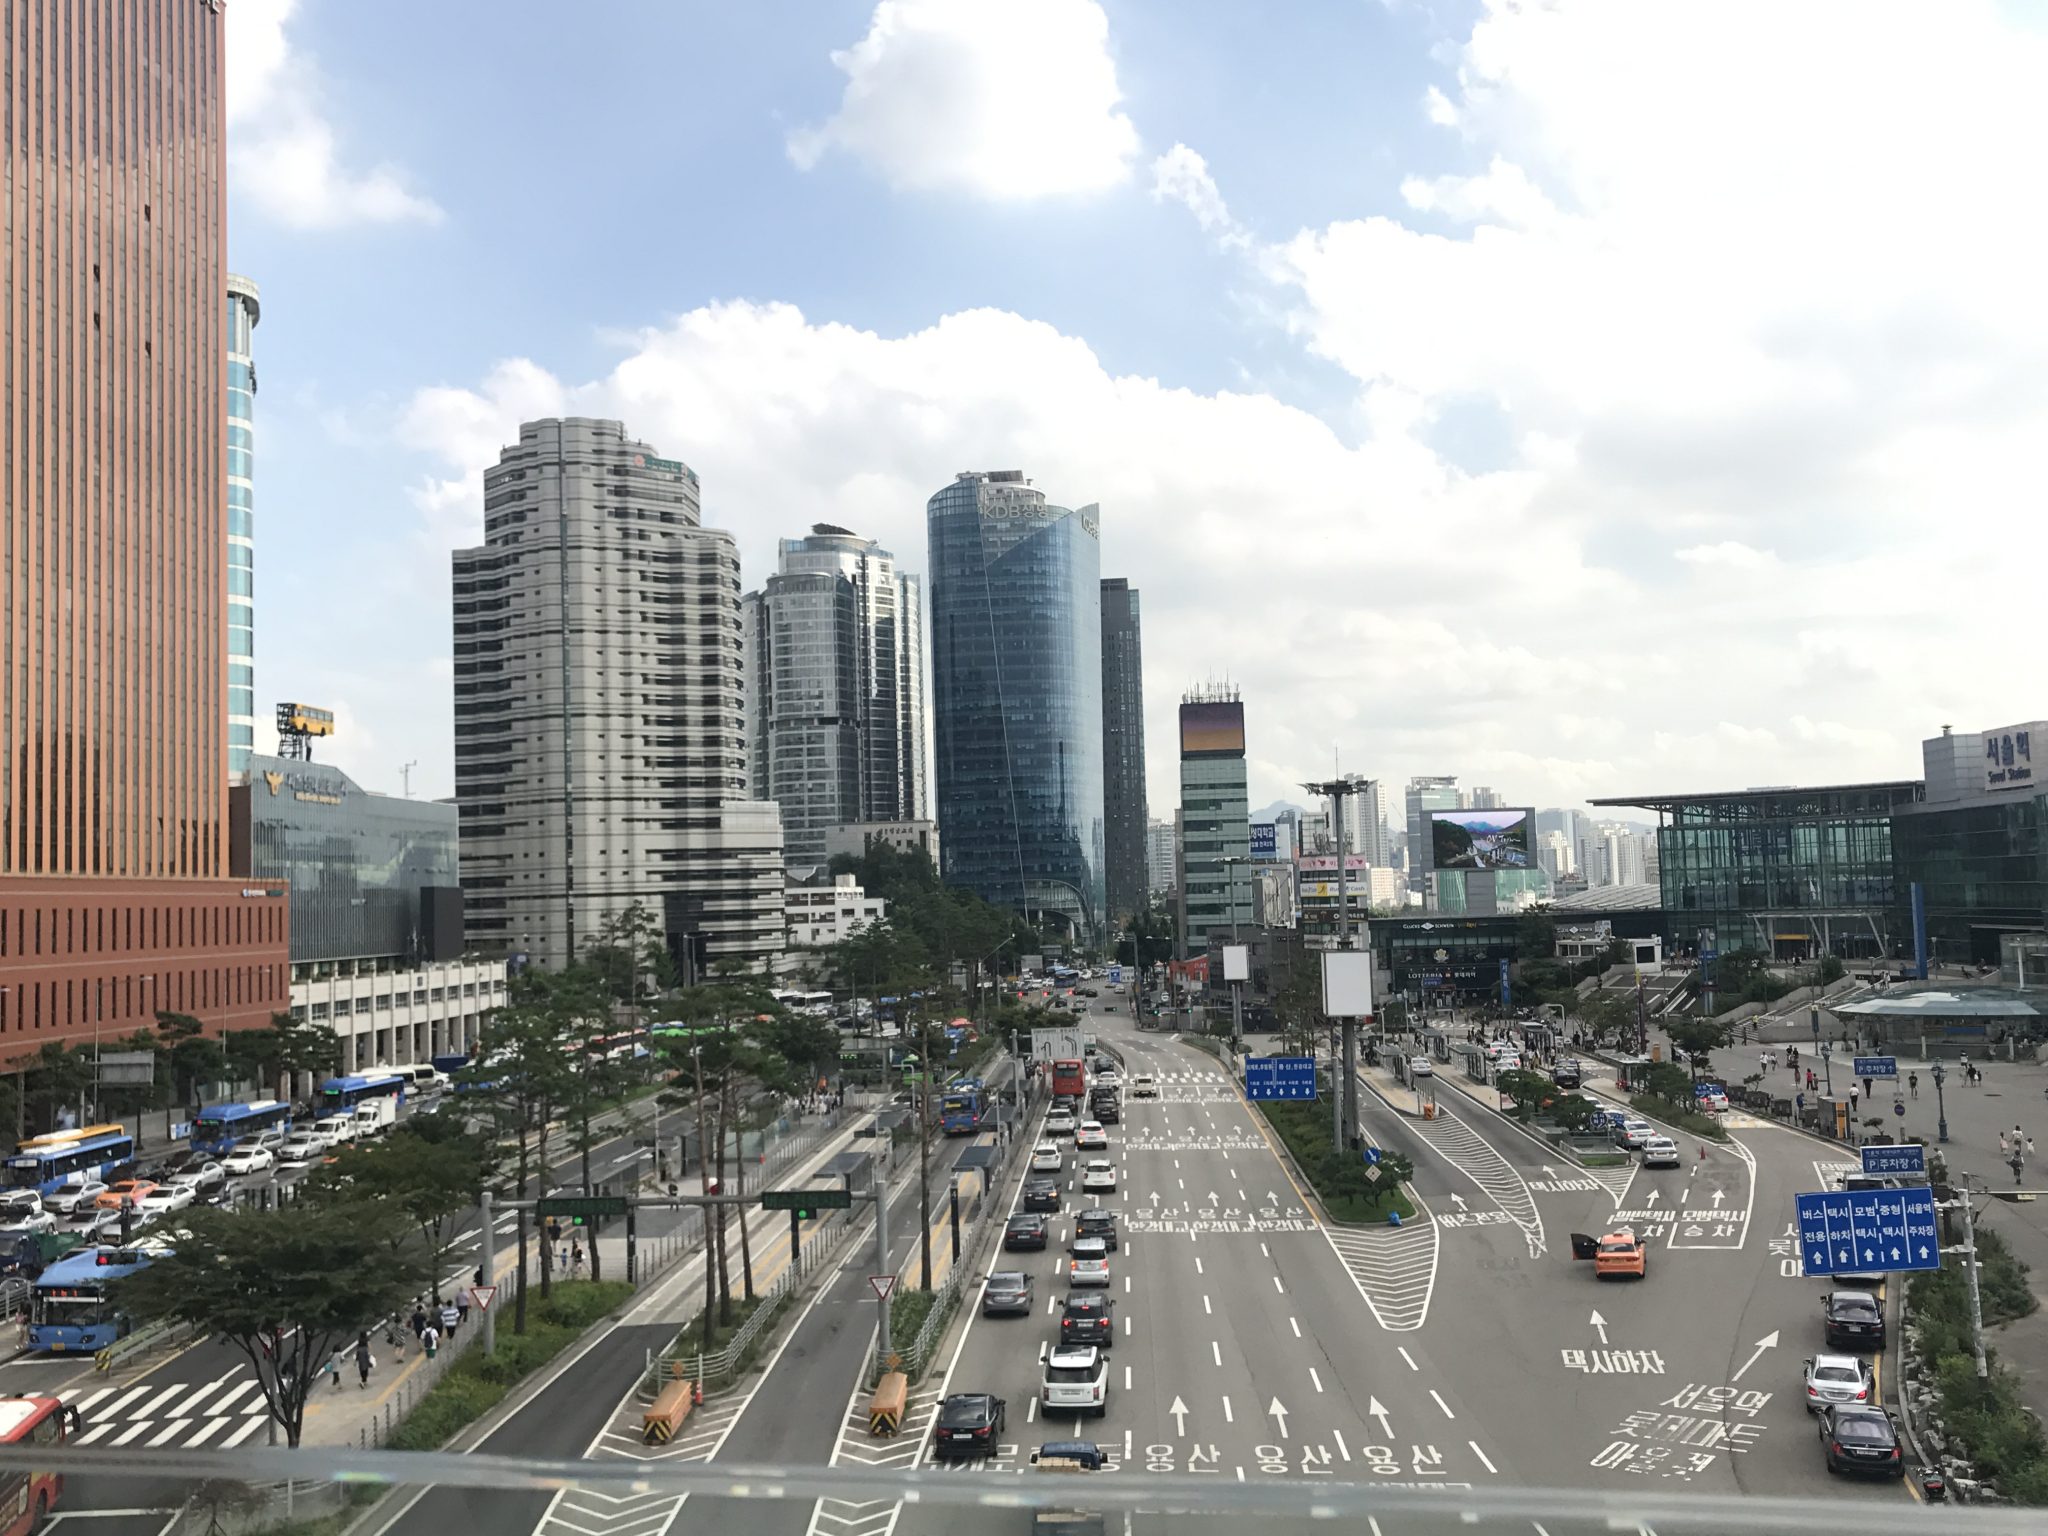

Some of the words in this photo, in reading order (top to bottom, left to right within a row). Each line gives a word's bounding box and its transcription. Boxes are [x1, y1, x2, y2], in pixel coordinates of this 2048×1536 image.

[984, 504, 1048, 519] KDB생명
[1987, 732, 2031, 766] 서울역
[1988, 768, 2006, 785] Seoul
[2008, 766, 2031, 781] Station
[1866, 1065, 1886, 1073] 주차장
[1869, 1160, 1876, 1169] P
[1879, 1158, 1910, 1170] 주차장
[1528, 1178, 1600, 1193] 택시하차
[1437, 1210, 1513, 1228] 버스전용
[1613, 1210, 1676, 1222] 일반택시
[1681, 1210, 1746, 1222] 모범택시
[1802, 1209, 1824, 1220] 버스
[1827, 1207, 1849, 1219] 택시
[1854, 1206, 1876, 1217] 모범
[1880, 1204, 1901, 1215] 중형
[1907, 1203, 1932, 1215] 서울역
[1128, 1219, 1189, 1233] 한강대교
[1192, 1219, 1256, 1233] 한강대교
[1257, 1218, 1319, 1232] 한강대교
[1804, 1231, 1826, 1243] 전용
[1830, 1229, 1851, 1241] 하차
[1855, 1227, 1877, 1239] 택시
[1882, 1226, 1904, 1237] 택시
[1909, 1225, 1934, 1236] 주차장
[1561, 1349, 1665, 1374] 택시하차
[1659, 1383, 1774, 1417] 서울역
[1609, 1410, 1767, 1453] 롯데마트
[1145, 1443, 1221, 1473] 용산
[1255, 1444, 1334, 1474] 용산
[1363, 1445, 1448, 1475] 용산
[1590, 1441, 1716, 1481] 아울렛
